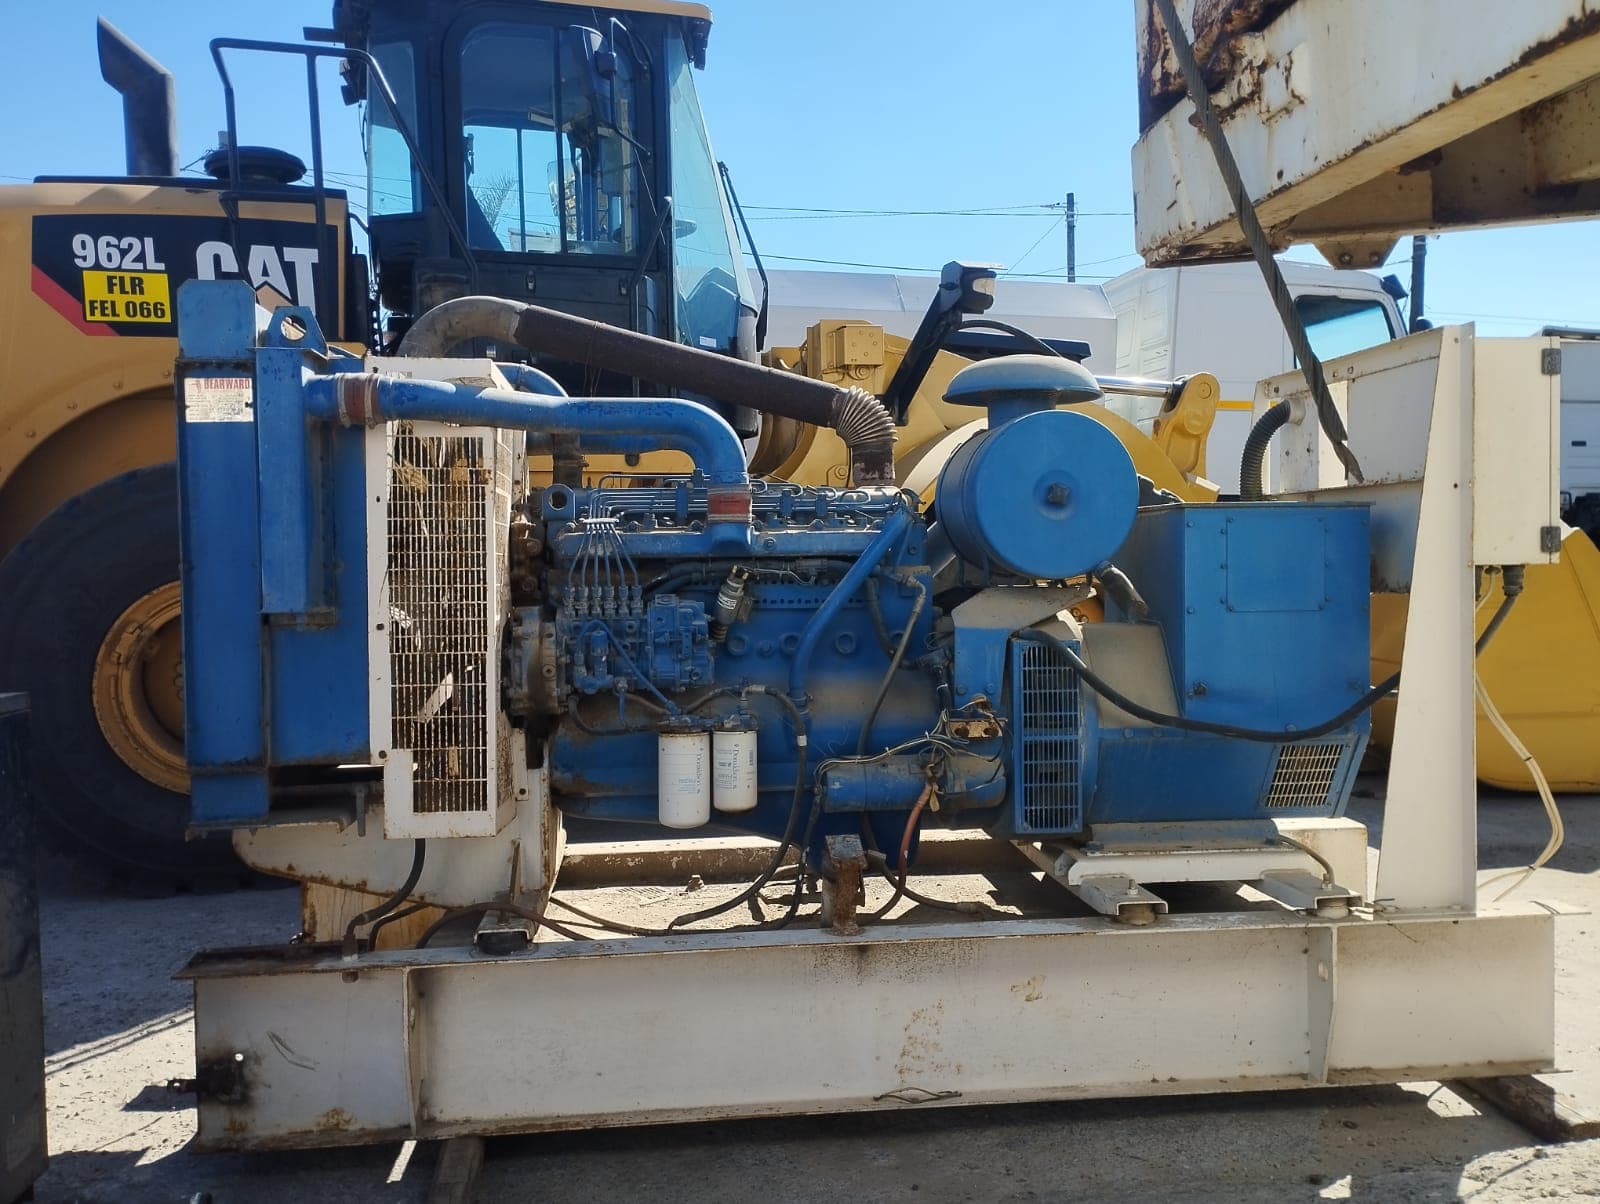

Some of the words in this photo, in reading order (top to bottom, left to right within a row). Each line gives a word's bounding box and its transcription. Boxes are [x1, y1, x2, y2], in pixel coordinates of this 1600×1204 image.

[72, 233, 166, 271] 962L
[106, 275, 145, 296] FLR
[196, 241, 319, 318] CAT
[88, 299, 121, 317] FEL
[124, 300, 166, 318] 066
[204, 379, 250, 390] BEARWARD
